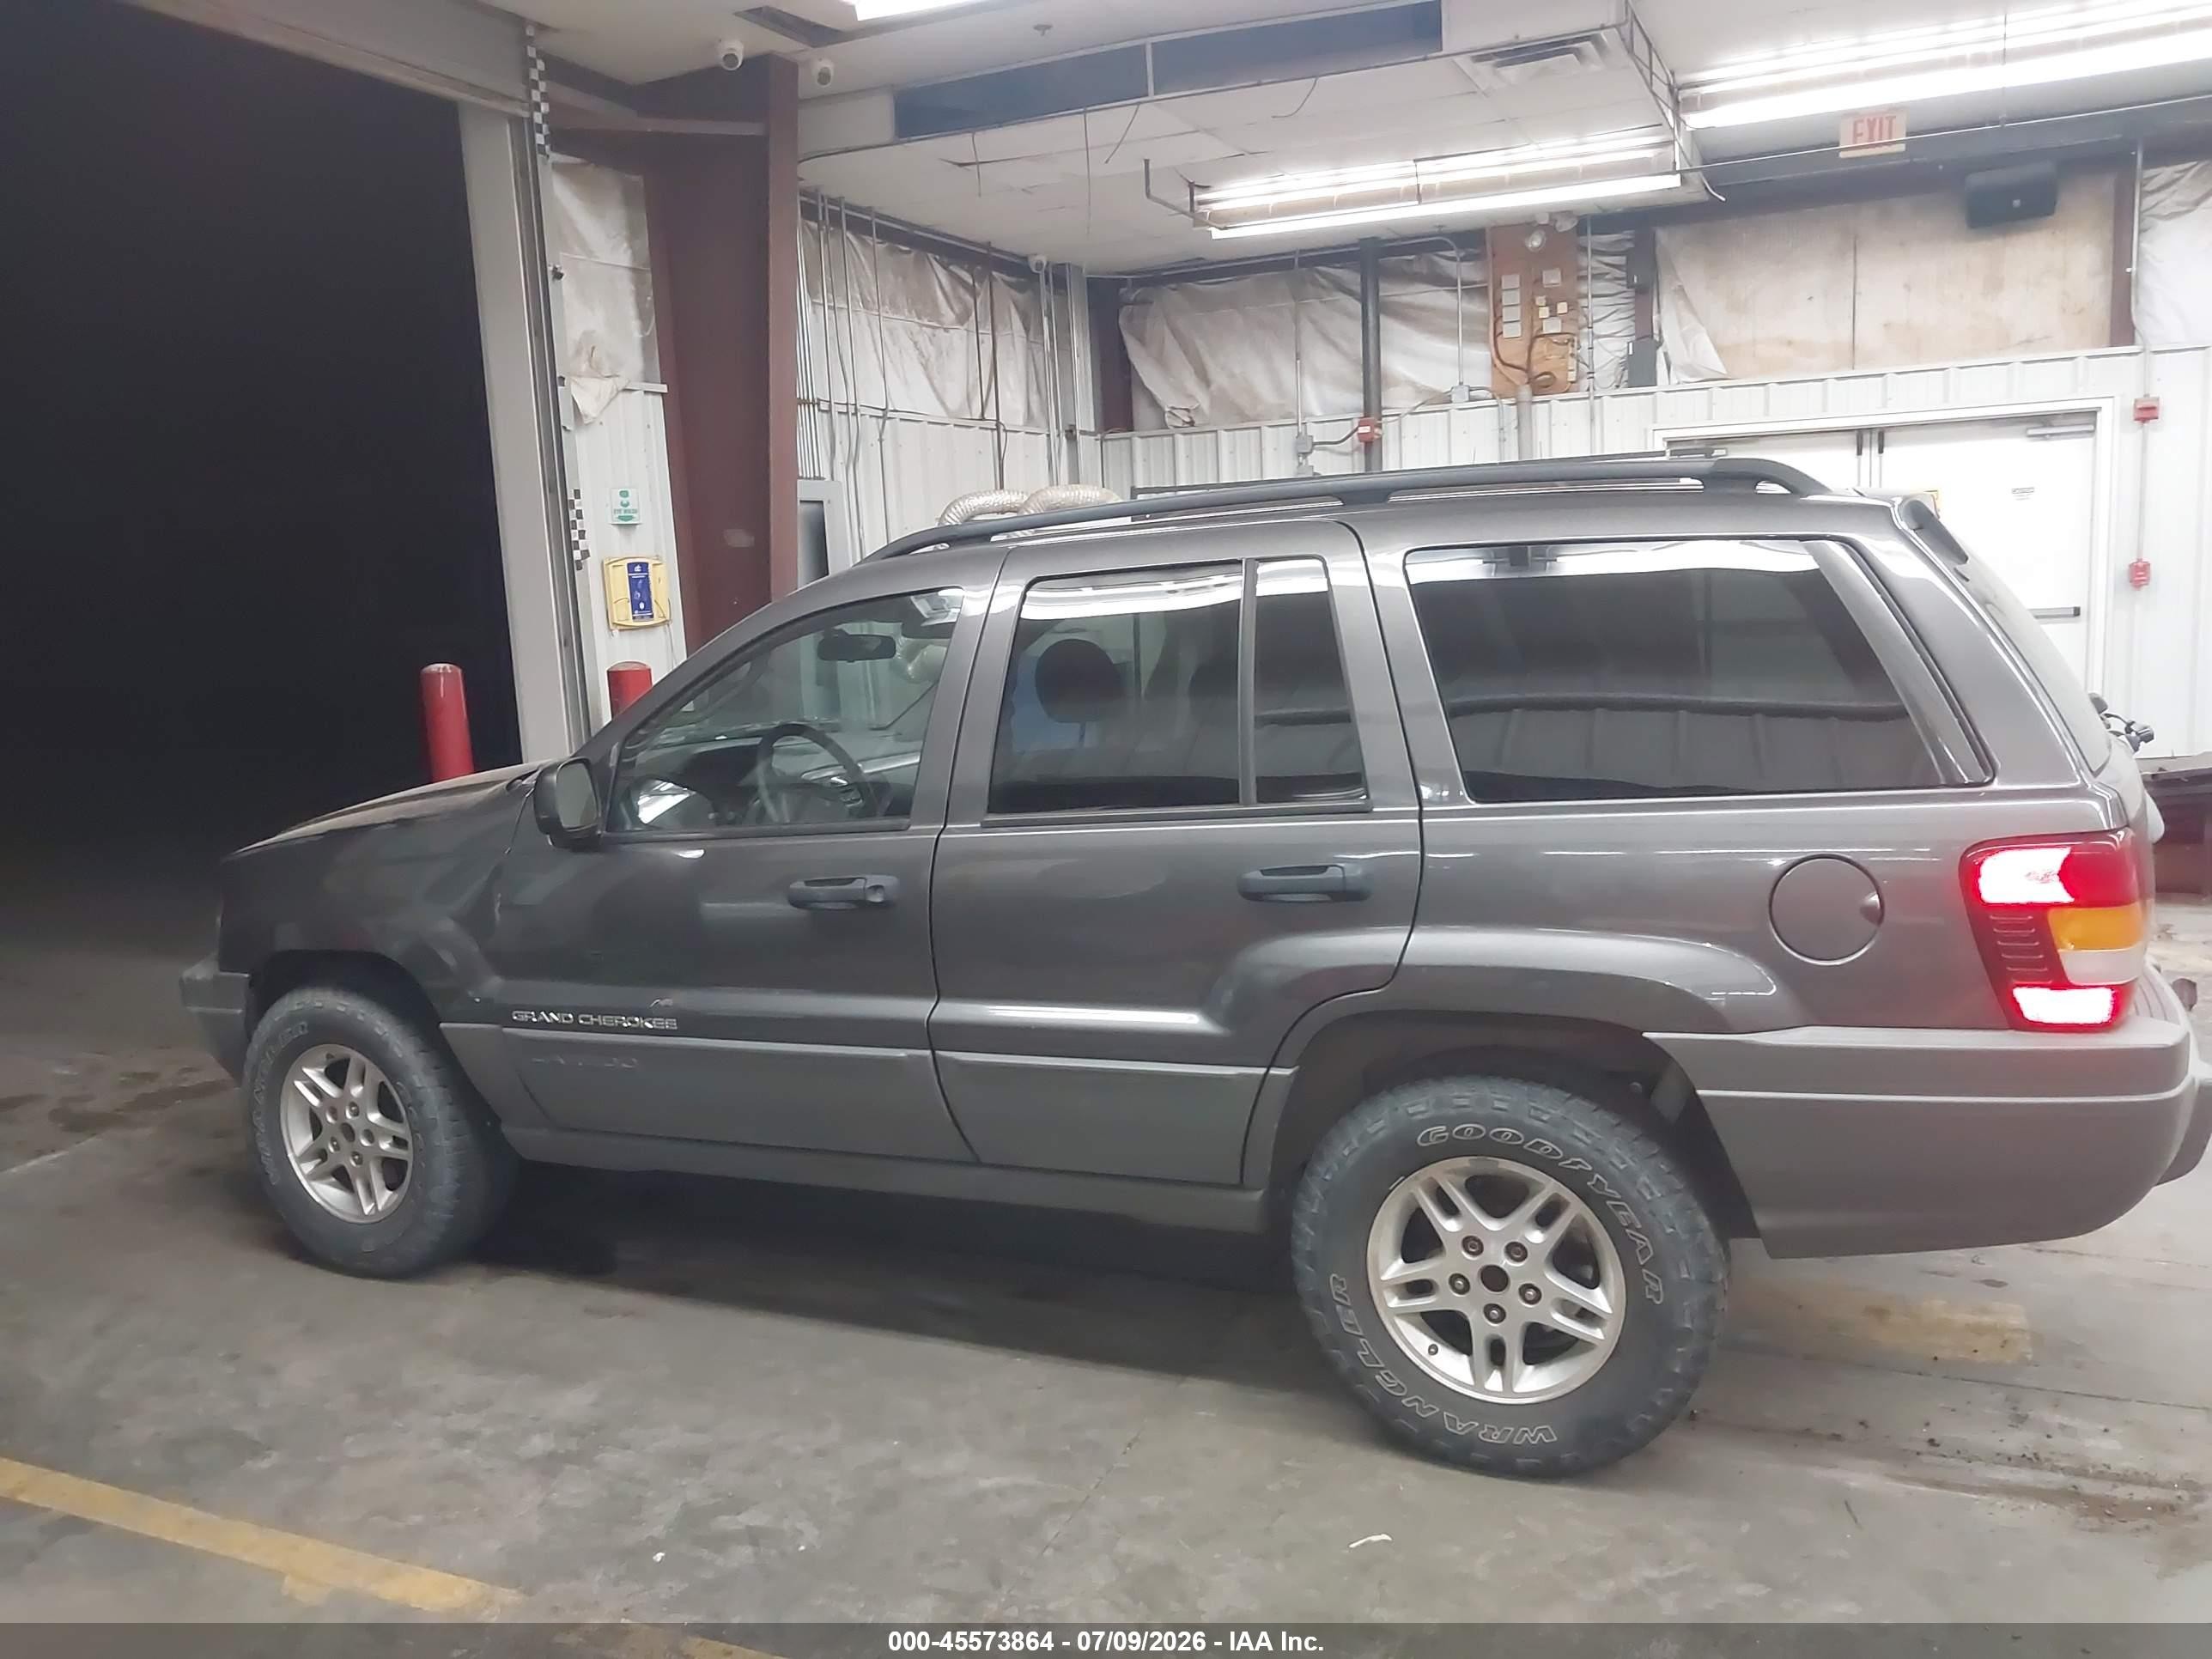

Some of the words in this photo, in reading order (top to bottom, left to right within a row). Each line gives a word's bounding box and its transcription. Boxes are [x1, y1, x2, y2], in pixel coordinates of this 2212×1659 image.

[1852, 115, 1897, 148] EXIT
[511, 1010, 574, 1024] GRAND
[578, 1013, 678, 1030] CHEROKEE
[1416, 1122, 1664, 1305] GOODYEAR
[1328, 1273, 1559, 1446] WRANGLER
